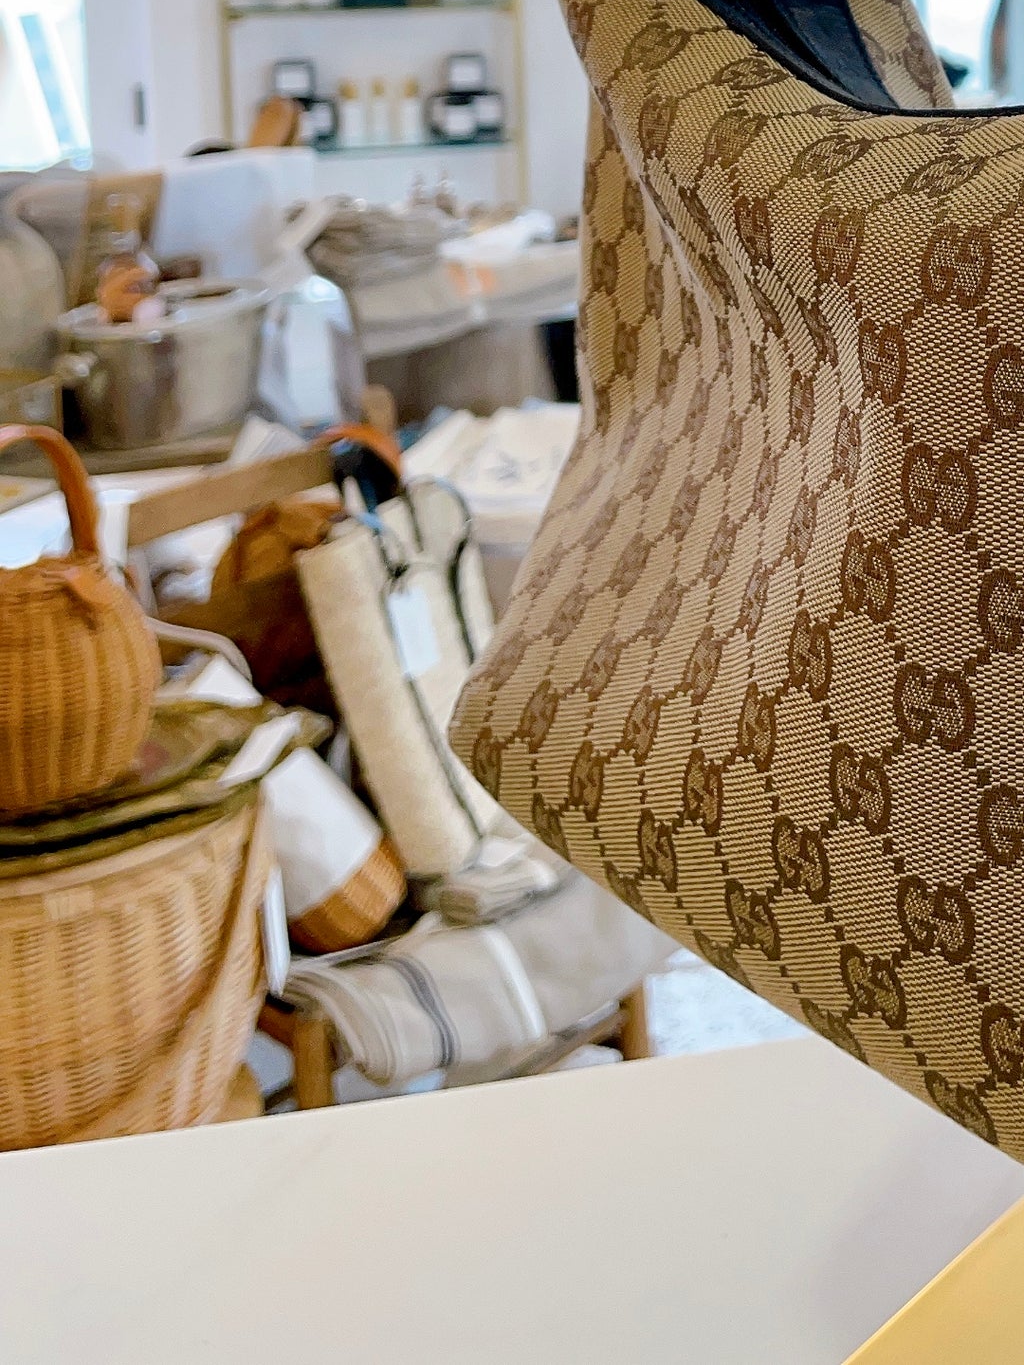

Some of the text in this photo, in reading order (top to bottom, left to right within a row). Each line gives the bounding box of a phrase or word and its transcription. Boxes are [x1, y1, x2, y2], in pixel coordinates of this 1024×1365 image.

[919, 222, 994, 309] GG
[900, 442, 976, 529] GG
[894, 663, 972, 748] GG
[828, 745, 892, 836] GG
[896, 874, 975, 964] GG
